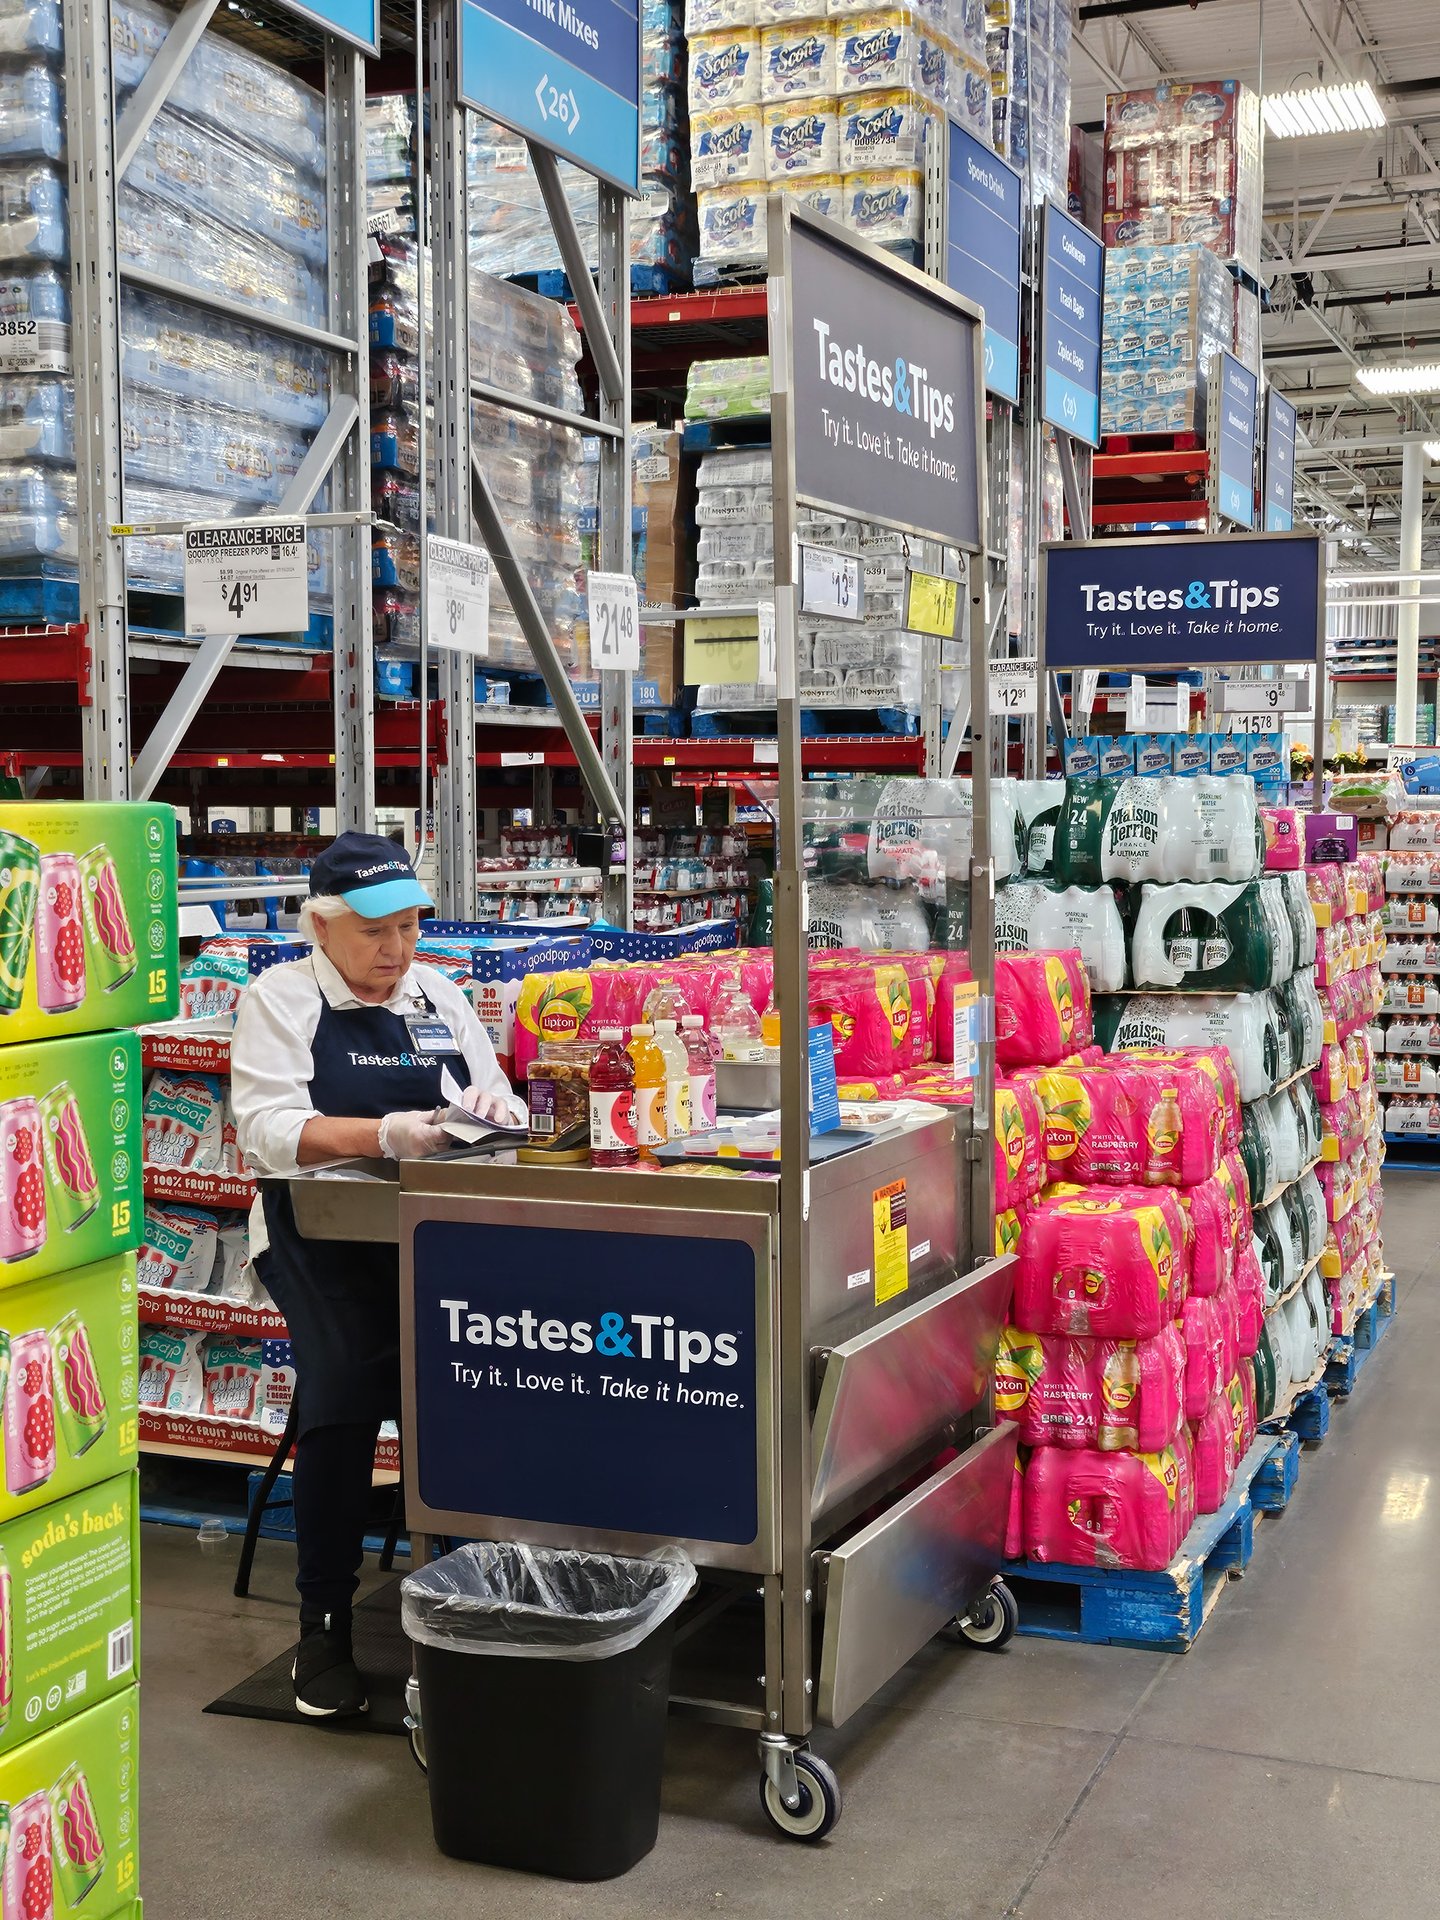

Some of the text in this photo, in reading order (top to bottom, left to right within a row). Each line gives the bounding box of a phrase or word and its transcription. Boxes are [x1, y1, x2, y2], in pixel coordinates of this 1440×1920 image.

[558, 0, 599, 50] Mixes
[852, 27, 893, 64] Scott
[703, 43, 740, 79] Scott
[855, 107, 894, 139] Scott
[967, 157, 1004, 200] Sports Drink
[860, 185, 901, 219] Scott
[1062, 234, 1086, 266] Cookware
[1059, 287, 1085, 320] Trash Bags
[1058, 340, 1084, 373] Ziploc Bags
[813, 318, 956, 439] Tastes&Tips
[821, 408, 959, 484] Try it. Love it. Take it home.
[711, 506, 745, 514] MONSTER
[188, 526, 302, 548] CLEARANCE PRICE
[187, 546, 269, 559] GOODPOP FREEZER POPS
[430, 543, 488, 573] CLEARANCE PRICE
[1081, 580, 1281, 614] Tastes&Tips
[1086, 617, 1283, 639] Try it. Love it. Take it home.
[639, 687, 655, 699] 180
[800, 689, 836, 698] MONSTER
[860, 688, 896, 696] MONSTER
[1071, 755, 1093, 764] POWER
[1106, 754, 1127, 763] POWER
[1109, 760, 1125, 768] FLEX
[1143, 753, 1165, 762] POWER
[1146, 759, 1162, 768] FLEX
[1180, 752, 1203, 760] POWER
[1183, 758, 1200, 766] FLEX
[1074, 761, 1090, 769] FLEX
[1070, 809, 1088, 826] 24
[1109, 805, 1159, 828] Maison
[150, 825, 161, 842] 5g
[1109, 822, 1158, 856] Perrier
[355, 860, 409, 879] Tastes&Tips
[1401, 879, 1422, 887] ZERO
[948, 925, 963, 940] 24
[694, 934, 723, 953] goodpop
[527, 951, 571, 971] goodpop
[1396, 958, 1418, 966] ZERO
[184, 961, 248, 979] goodpop
[148, 969, 167, 995] 15
[187, 992, 202, 1002] NO
[482, 988, 496, 999] 30
[477, 1000, 502, 1009] CHERRY
[482, 1009, 503, 1017] BERRY
[544, 1017, 574, 1031] Lipton
[1118, 1021, 1166, 1047] Maison
[151, 1042, 213, 1057] 100% FRUIT
[1401, 1039, 1422, 1047] ZERO
[114, 1055, 125, 1072] 5g
[348, 1052, 437, 1067] Tastes&Tips
[147, 1128, 162, 1140] NO
[1091, 1140, 1139, 1149] RASPBERRY
[1123, 1162, 1140, 1172] 24
[153, 1174, 247, 1195] 100% FRUIT JUICE
[111, 1200, 131, 1228] 15
[176, 1226, 192, 1236] POPS
[164, 1302, 287, 1328] 100% FRUIT JUICE POPS
[440, 1299, 740, 1374] Tastes&Tips
[271, 1372, 286, 1383] 30
[451, 1362, 745, 1409] Try it. Love it. Take it home.
[211, 1381, 225, 1393] NO
[266, 1384, 291, 1393] CHERRY
[270, 1392, 292, 1400] BERRY
[1043, 1391, 1094, 1401] RASPBERRY
[1076, 1414, 1094, 1426] 24
[119, 1419, 137, 1448] 15
[165, 1421, 260, 1443] 100% FRUIT JUICE
[21, 1502, 125, 1569] soda's back
[116, 1851, 134, 1885] 15
